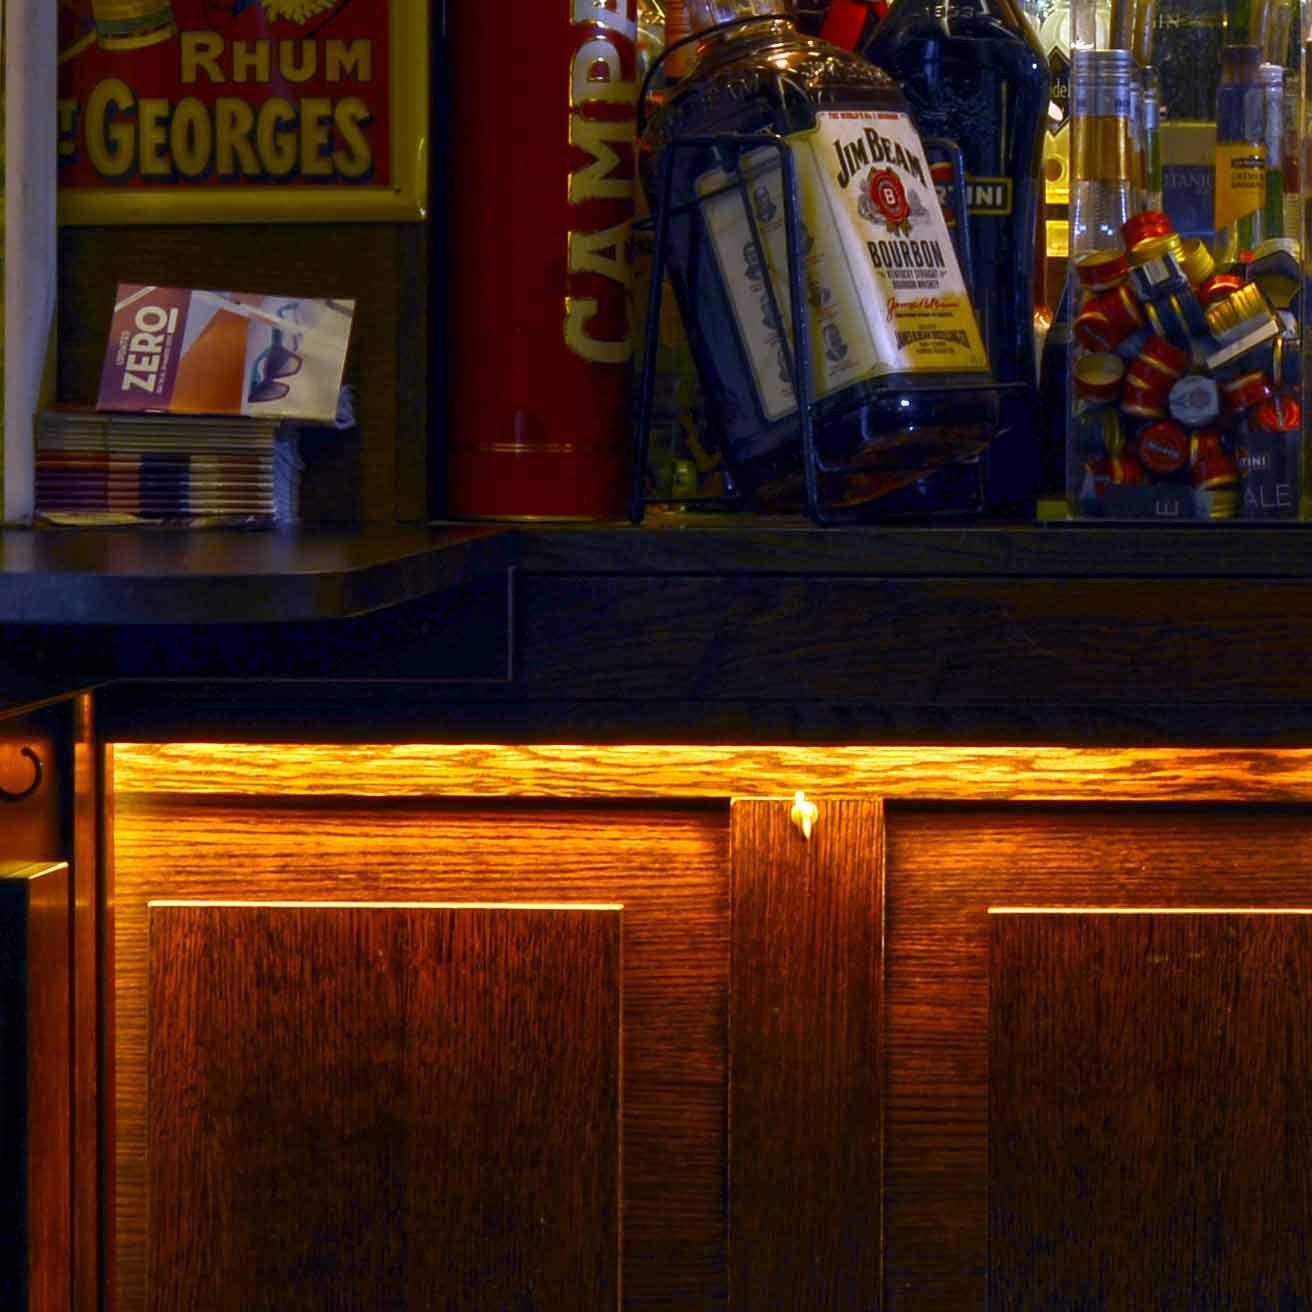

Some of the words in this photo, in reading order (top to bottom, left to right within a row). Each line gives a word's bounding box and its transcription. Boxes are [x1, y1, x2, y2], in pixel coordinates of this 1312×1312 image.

[180, 31, 372, 84] RHUM
[85, 77, 374, 178] GEORGES
[832, 136, 864, 189] JIM
[864, 127, 927, 188] BEAM
[883, 185, 896, 204] B
[867, 239, 945, 269] BOURBON
[121, 304, 169, 393] ZERO
